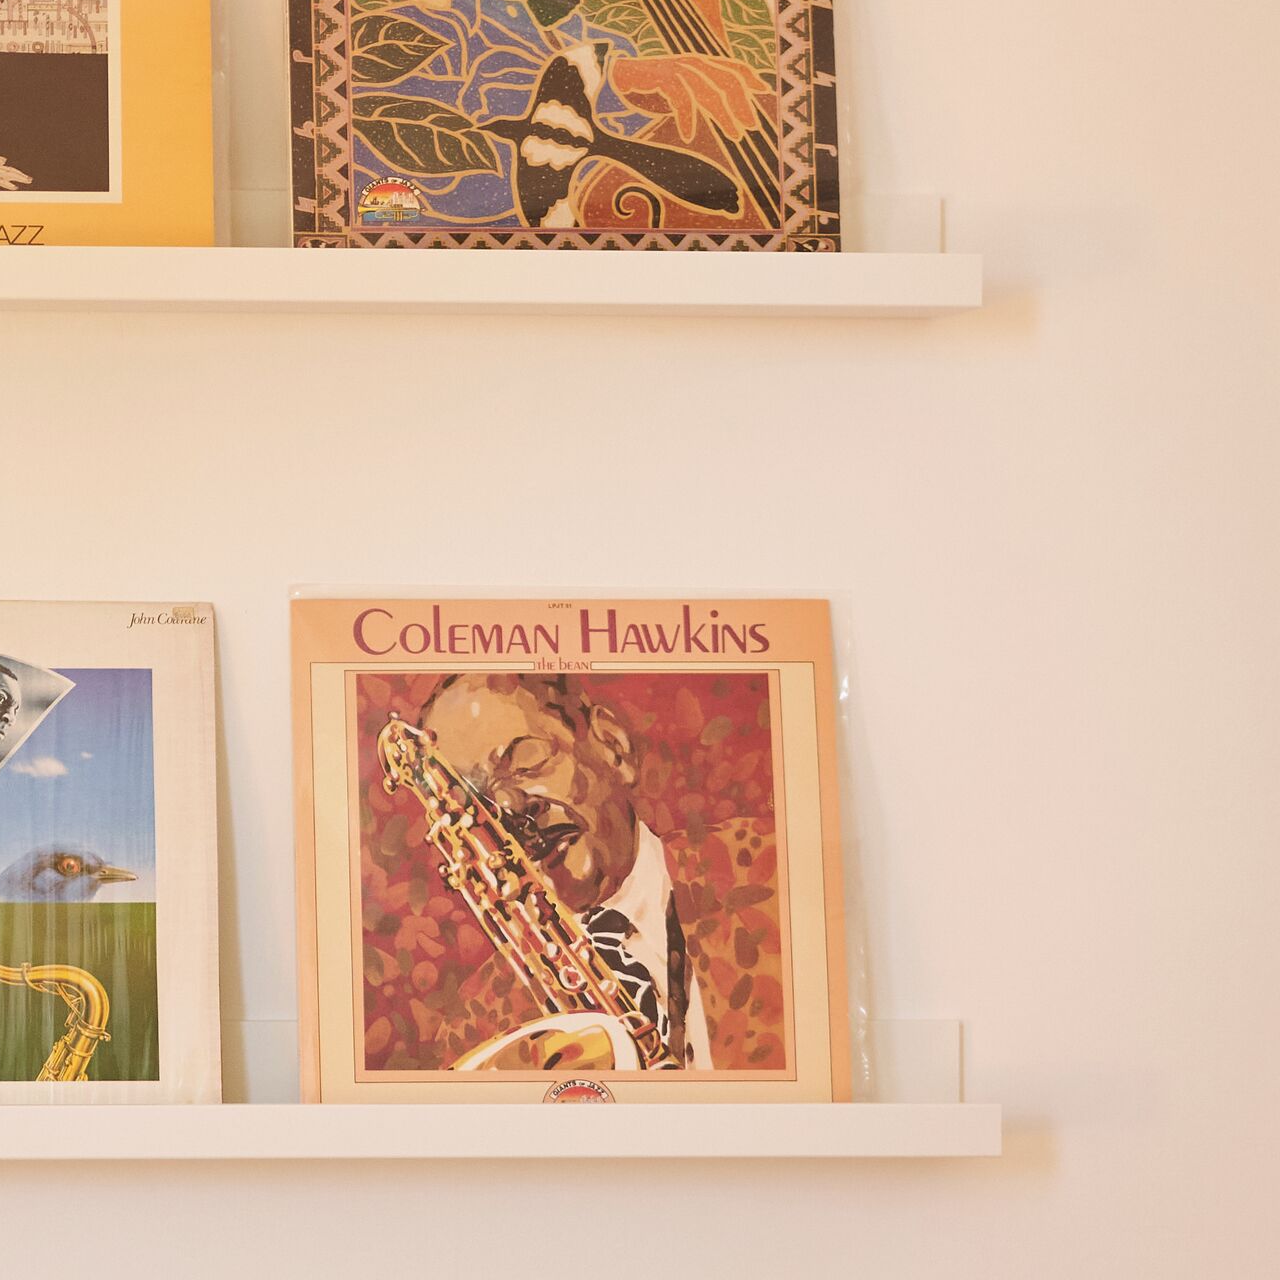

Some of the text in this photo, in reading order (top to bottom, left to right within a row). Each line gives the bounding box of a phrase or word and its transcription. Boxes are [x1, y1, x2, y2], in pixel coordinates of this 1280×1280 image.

[126, 612, 156, 629] John
[552, 1079, 577, 1096] GIANTS
[587, 1081, 605, 1094] JAZZ
